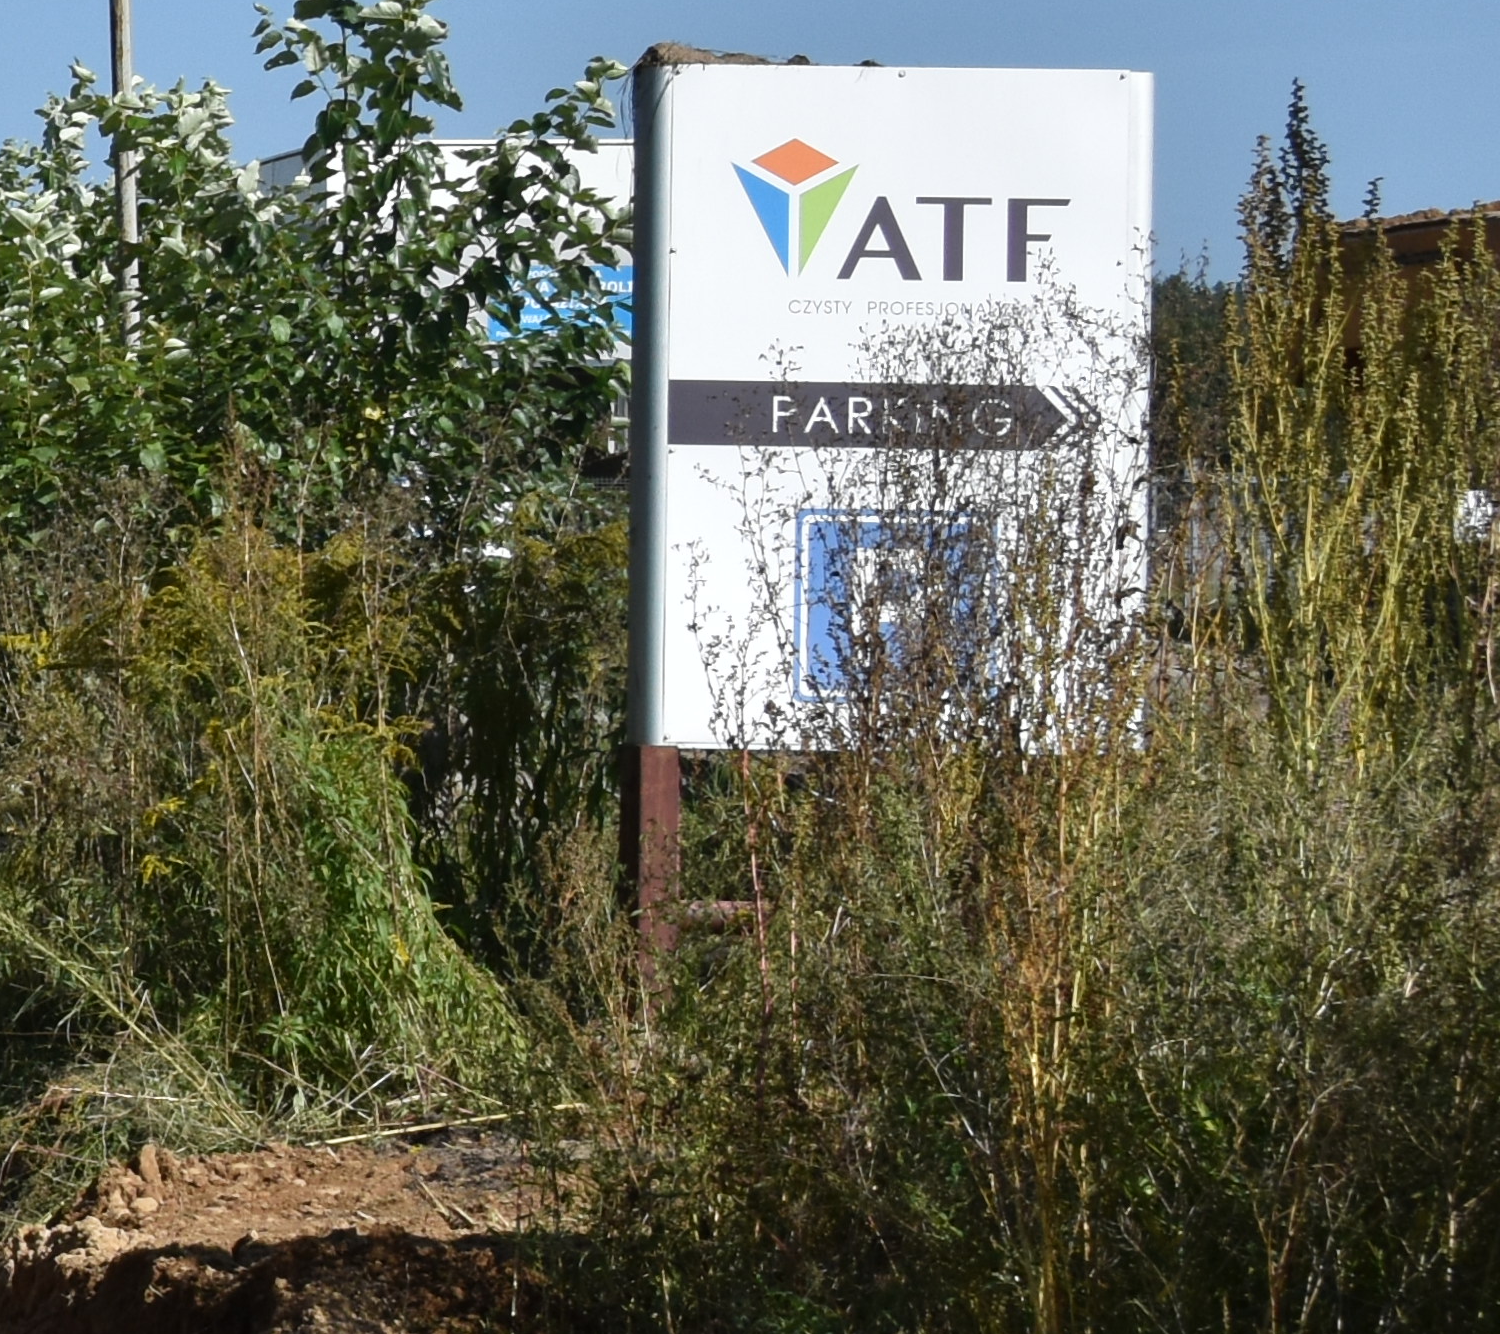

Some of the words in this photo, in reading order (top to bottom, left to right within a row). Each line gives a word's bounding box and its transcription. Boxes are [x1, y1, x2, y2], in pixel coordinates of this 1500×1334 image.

[837, 196, 1071, 282] ATF
[788, 299, 852, 315] CZYSTY
[771, 395, 1013, 436] PARKING
